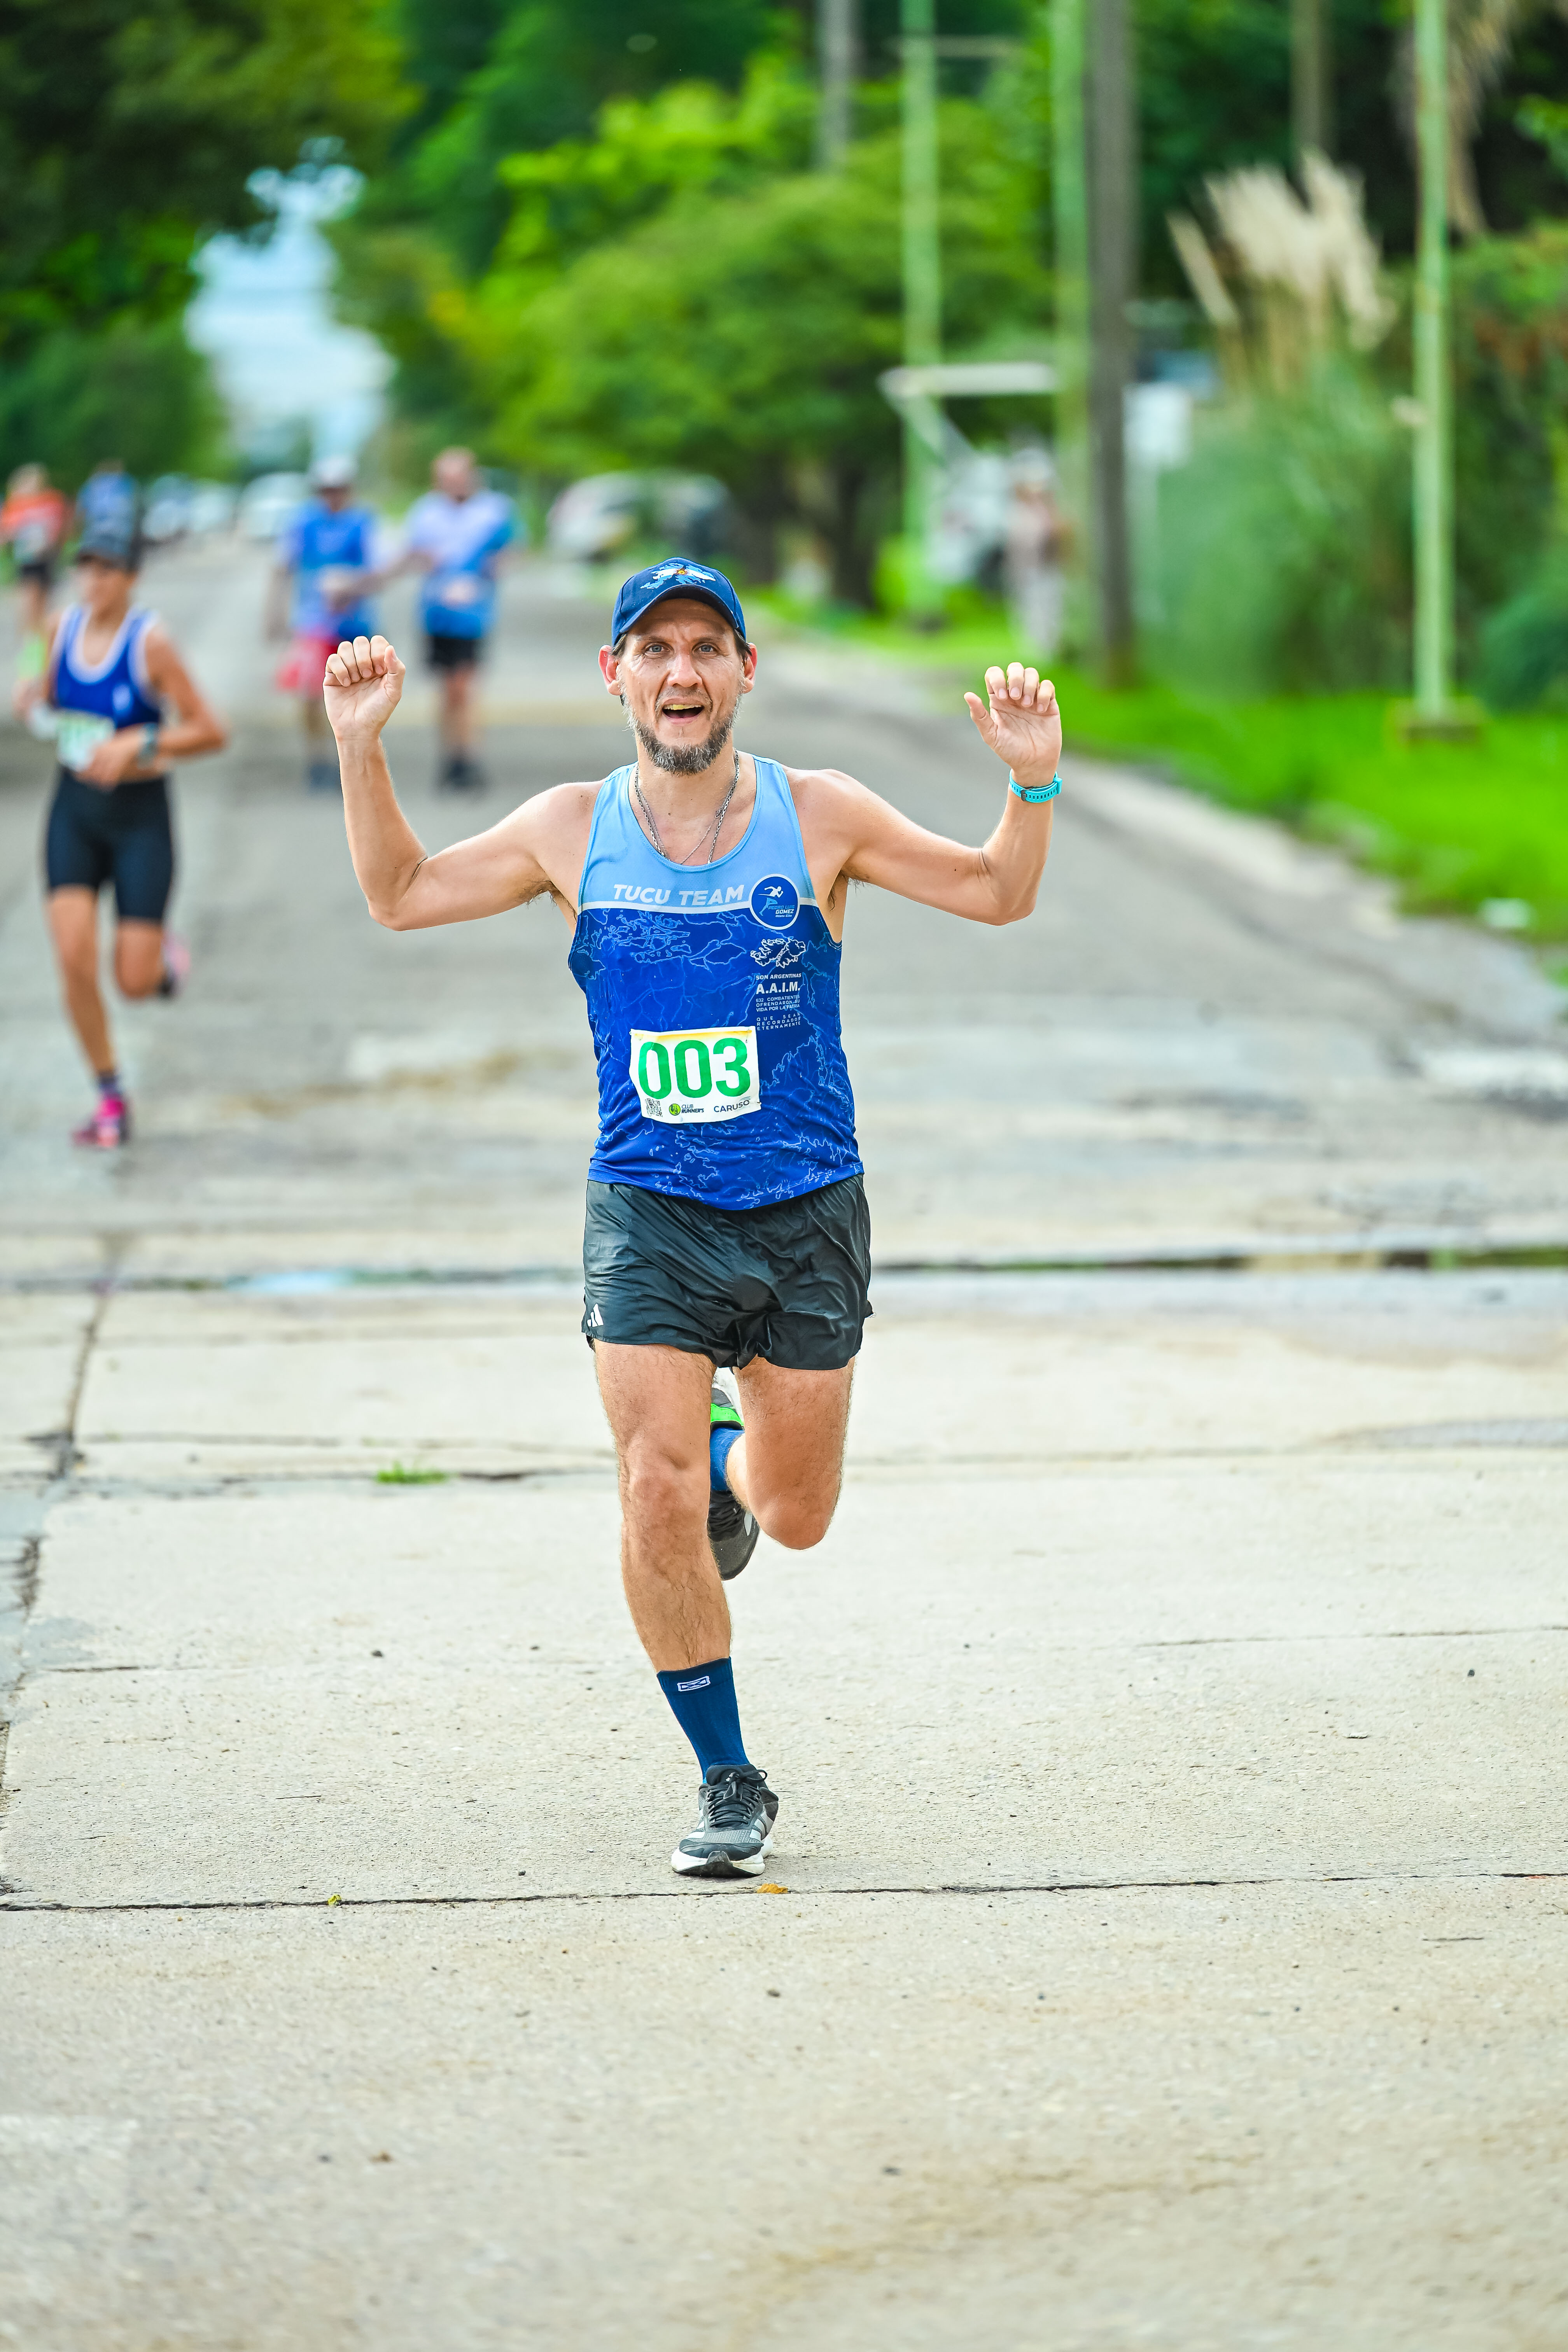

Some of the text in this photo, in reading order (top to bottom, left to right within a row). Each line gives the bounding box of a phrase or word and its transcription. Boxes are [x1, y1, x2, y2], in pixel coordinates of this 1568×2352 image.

[613, 884, 744, 906] TUCU TEAM
[756, 981, 800, 994] A.A.I.M.
[757, 1016, 801, 1026] RECORDADOS
[757, 1021, 801, 1031] ETERNAMENTE
[638, 1038, 751, 1099] 003
[714, 1099, 750, 1113] CARUSO
